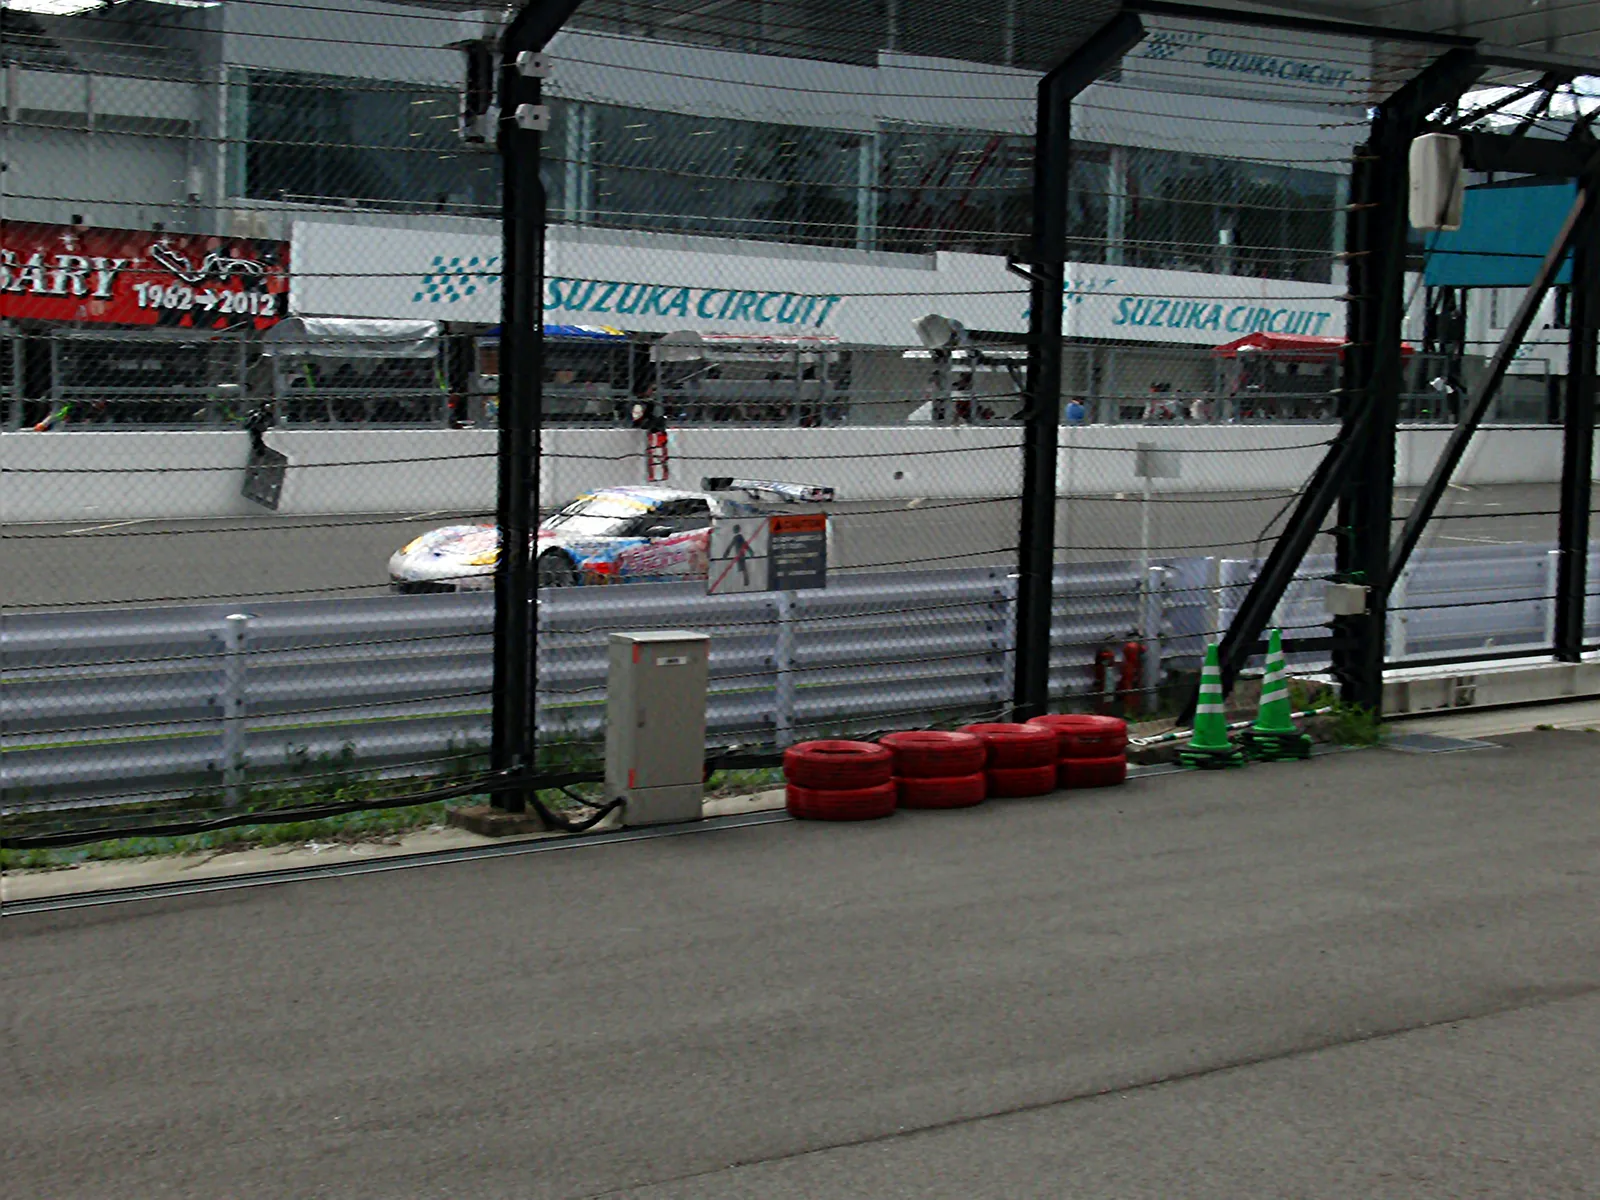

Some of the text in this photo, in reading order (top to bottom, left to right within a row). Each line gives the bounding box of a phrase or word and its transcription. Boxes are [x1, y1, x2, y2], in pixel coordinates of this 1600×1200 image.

[133, 281, 276, 317] 1962 2012
[543, 276, 841, 328] SUZUKA CIRCUIT
[1112, 297, 1331, 336] SUZUKA CIRCUIT
